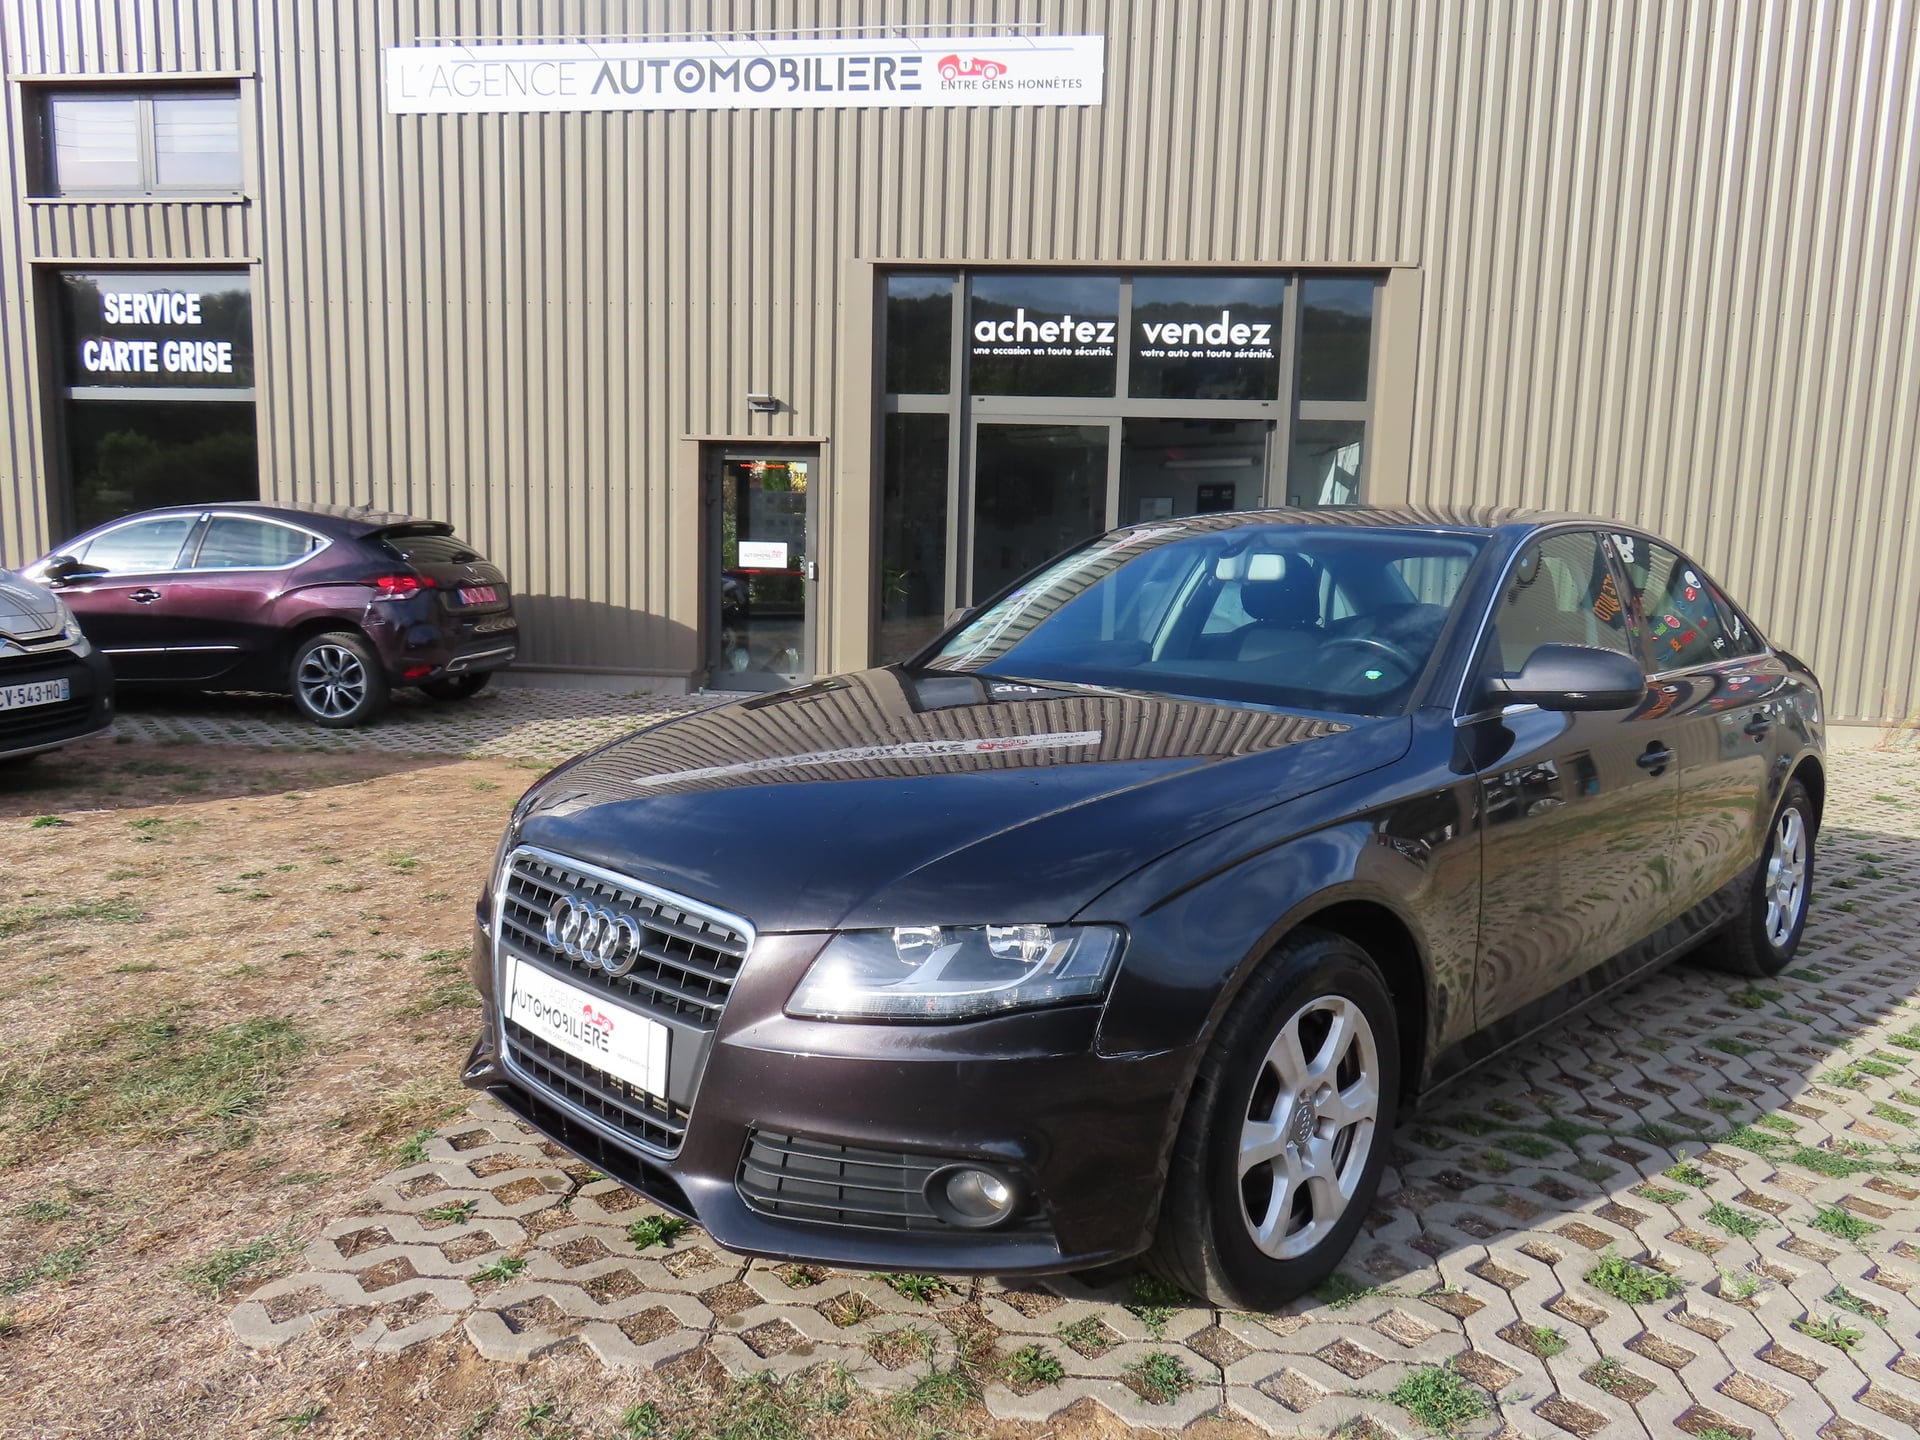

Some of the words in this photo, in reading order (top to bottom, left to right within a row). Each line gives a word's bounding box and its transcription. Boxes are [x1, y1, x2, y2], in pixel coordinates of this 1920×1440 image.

[400, 62, 577, 97] L'AGENCE
[590, 56, 923, 94] AUTOMOBILIERE
[941, 79, 978, 90] ENTRE
[982, 79, 1014, 89] GENS
[1017, 76, 1082, 89] HONNÊTES
[104, 293, 202, 324] SERVICE
[974, 308, 1115, 343] achetez
[1142, 310, 1271, 345] vendez
[83, 341, 158, 372] CARTE
[163, 341, 233, 373] GRISE
[973, 347, 990, 355] une
[992, 345, 1031, 356] occasion
[1033, 348, 1045, 356] en
[1047, 346, 1072, 356] toute
[1074, 345, 1114, 356] sécurité.
[1140, 348, 1165, 358] votre
[1167, 349, 1190, 358] auto
[1191, 350, 1204, 358] en
[1206, 349, 1232, 359] toute
[1234, 348, 1275, 359] sérénité.
[512, 987, 610, 1053] AUTOMOBILIERE
